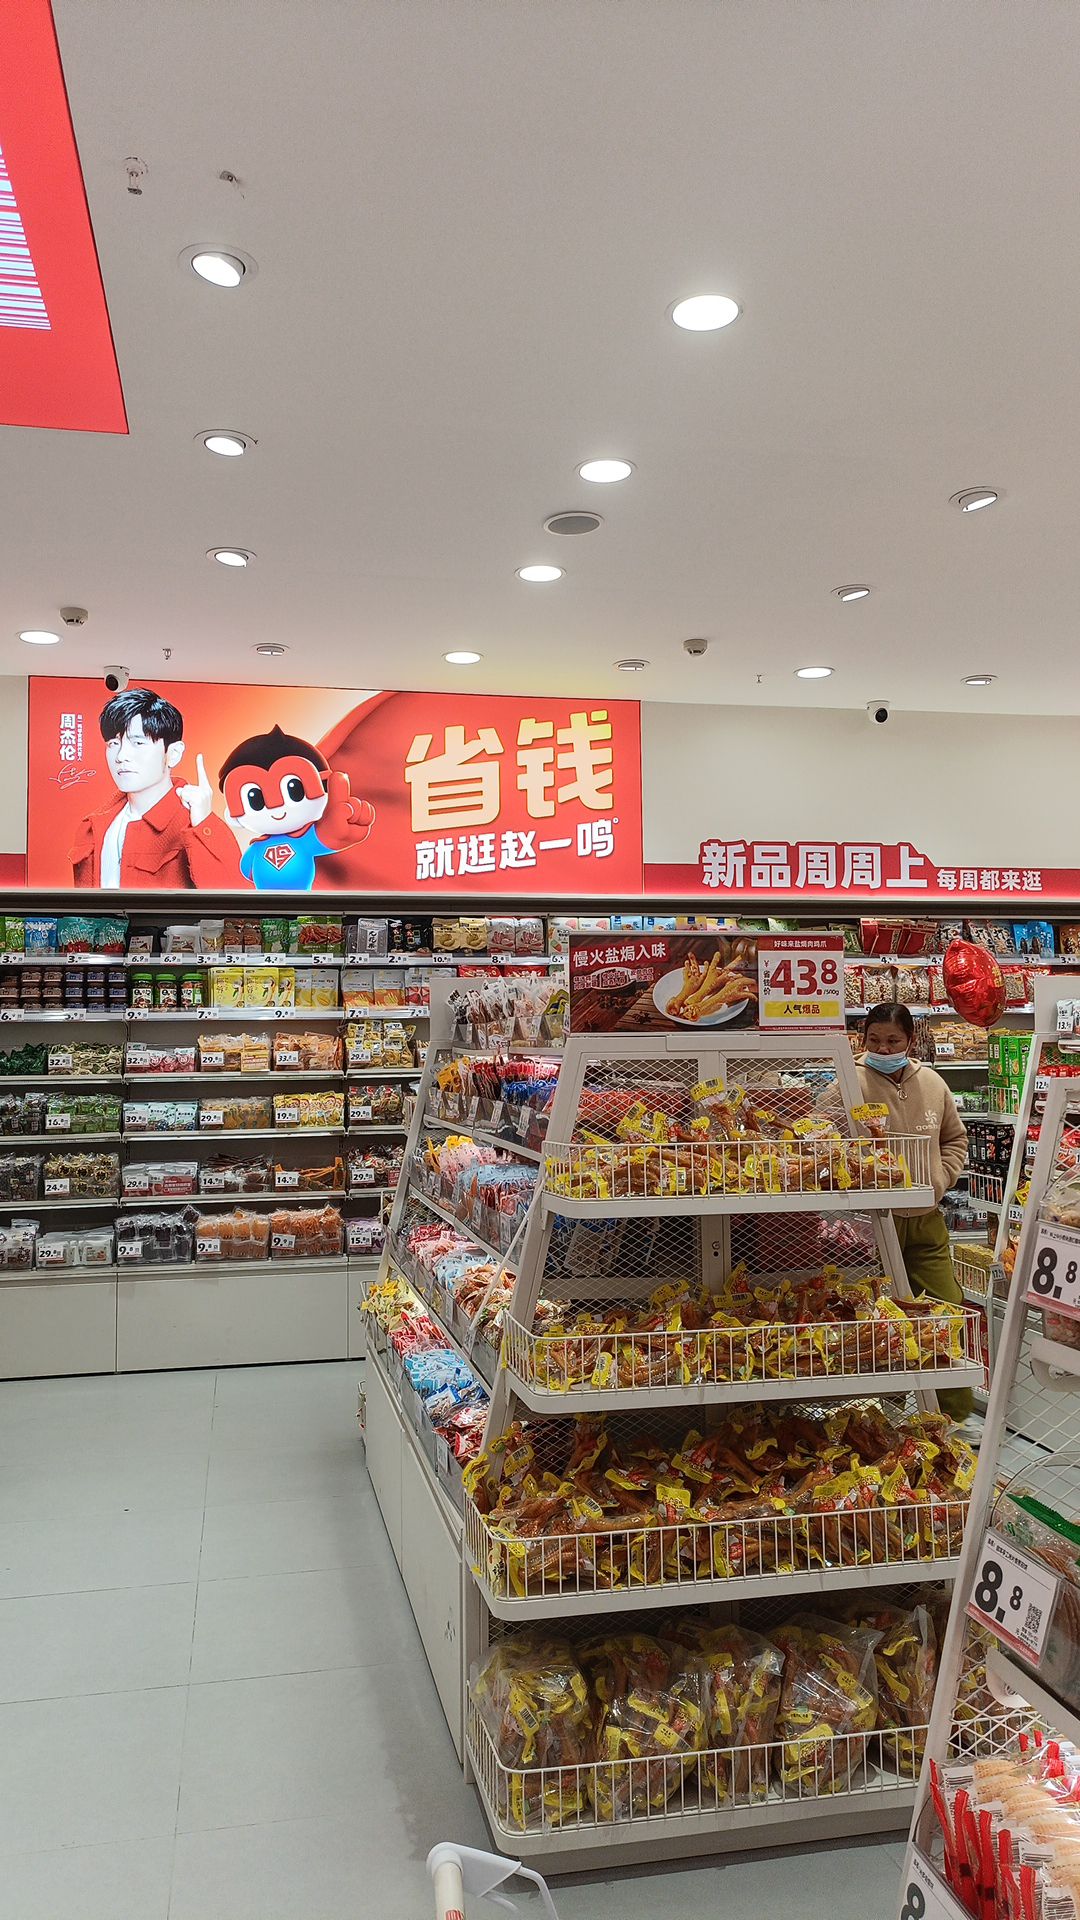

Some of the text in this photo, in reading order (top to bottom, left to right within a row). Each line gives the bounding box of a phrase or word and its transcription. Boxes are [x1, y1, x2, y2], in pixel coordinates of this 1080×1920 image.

[60, 713, 76, 761] 周杰伦
[404, 709, 613, 832] 省钱
[415, 818, 615, 880] 就逛赵一鸣
[702, 842, 928, 889] 新品周周上
[936, 868, 1043, 891] 每周都来逛
[572, 941, 666, 968] 慢火盐焗入味
